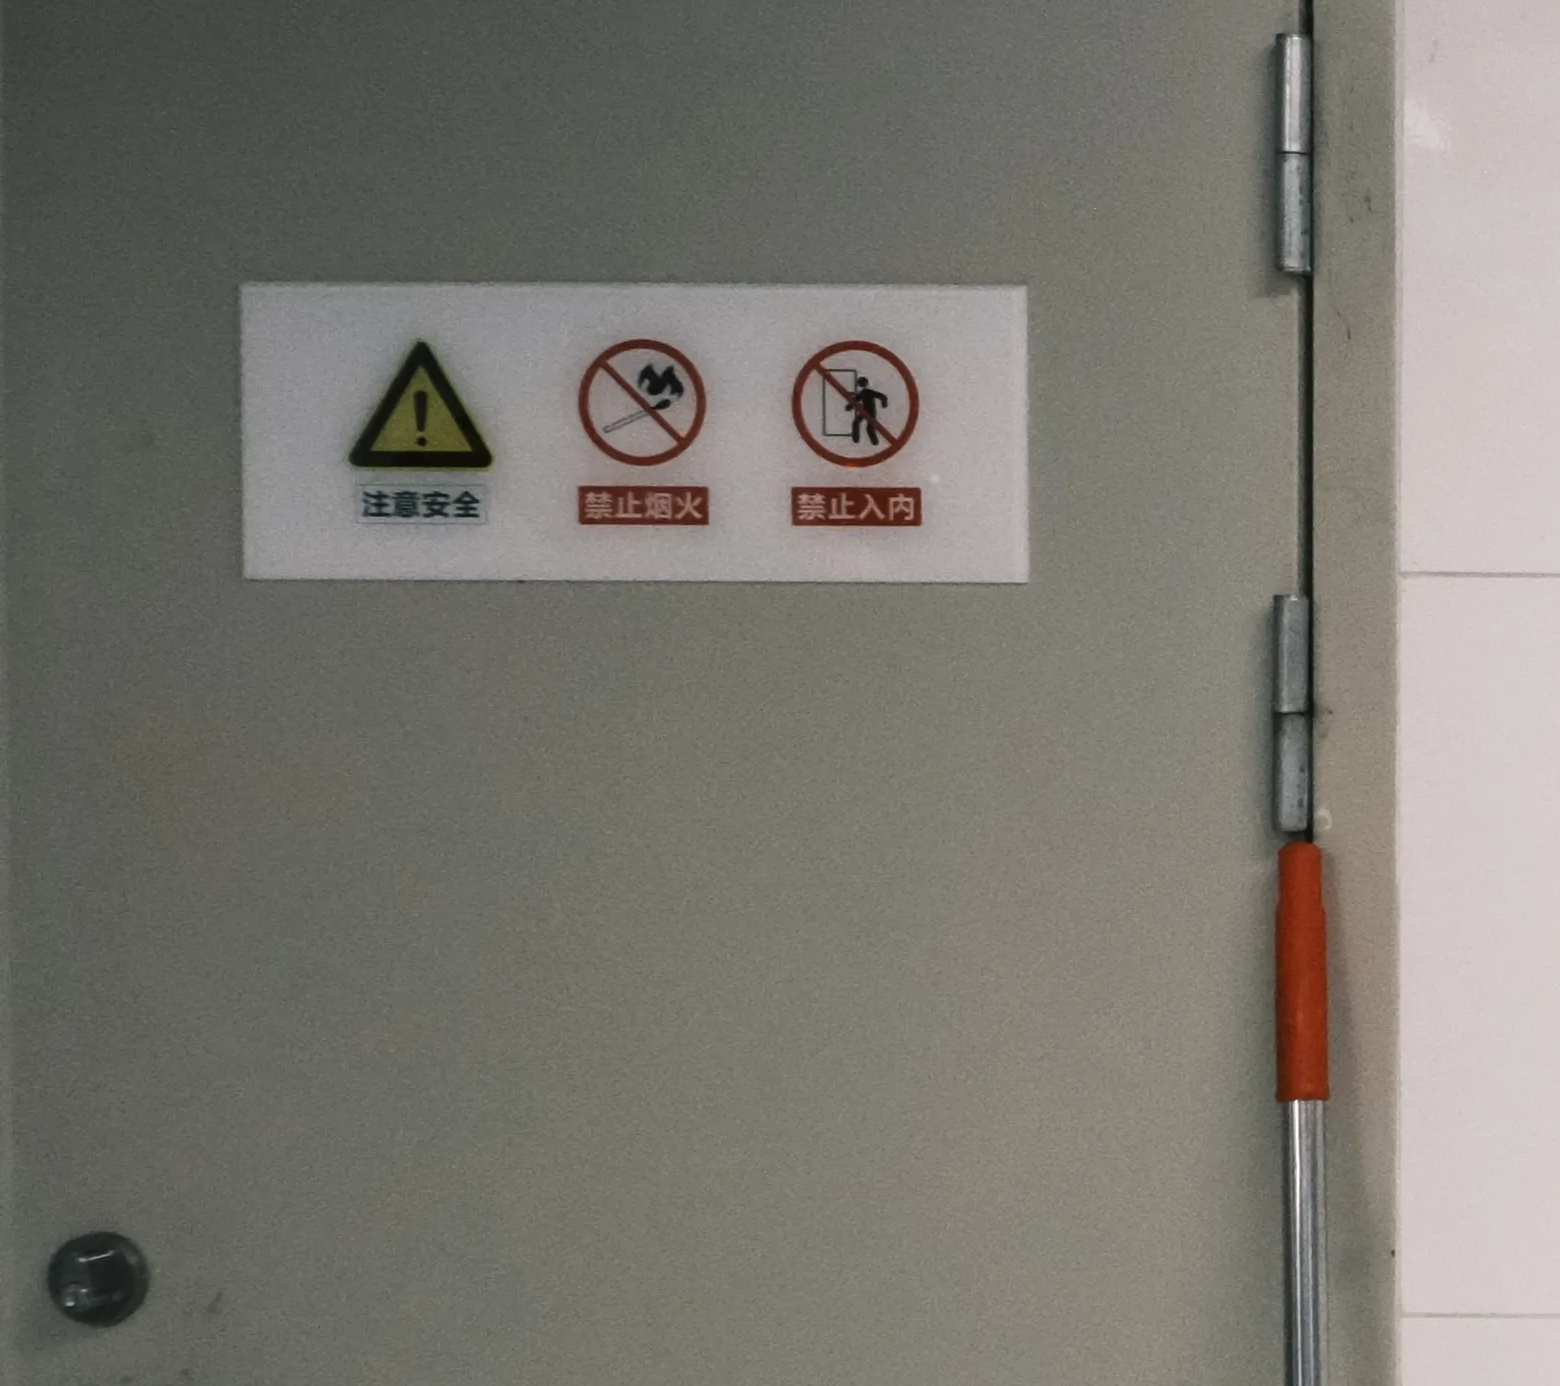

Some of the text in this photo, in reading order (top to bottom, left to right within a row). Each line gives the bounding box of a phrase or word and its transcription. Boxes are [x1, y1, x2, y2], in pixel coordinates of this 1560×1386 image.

[361, 489, 482, 521] 注意安全
[583, 491, 703, 524] 禁止烟火
[796, 491, 916, 524] 禁止入内
